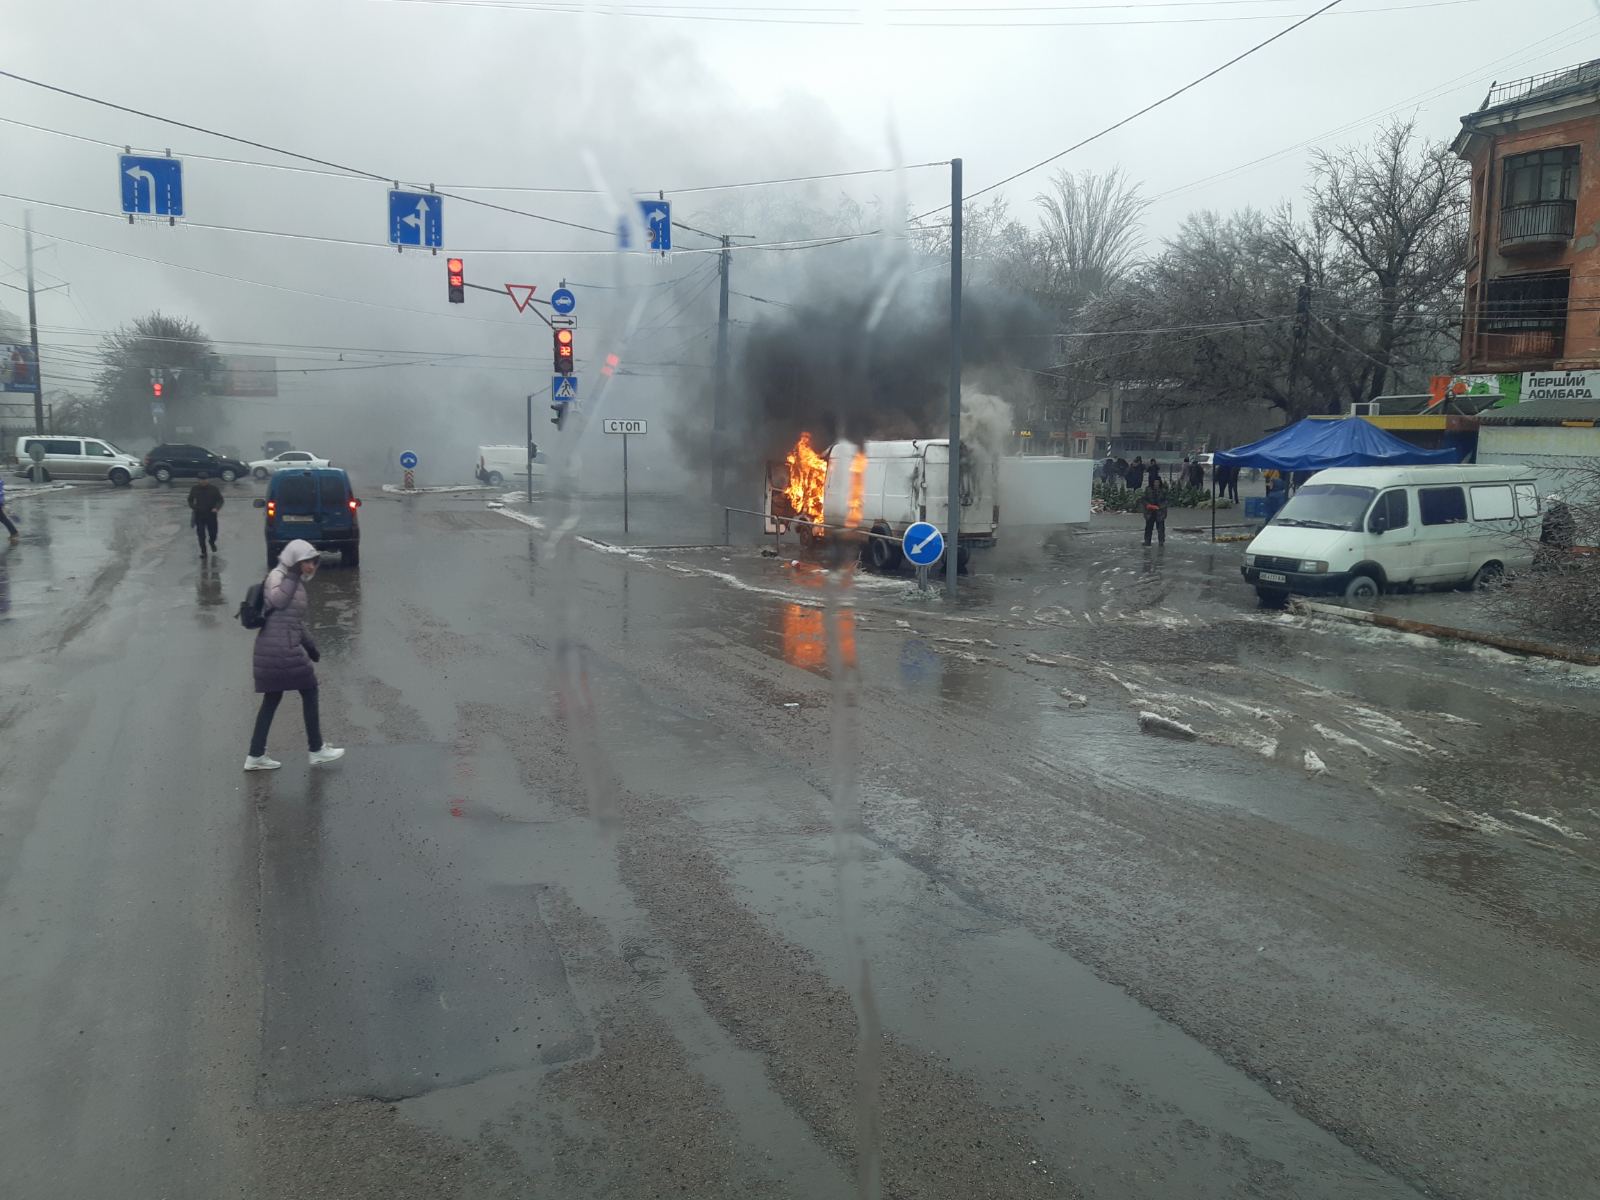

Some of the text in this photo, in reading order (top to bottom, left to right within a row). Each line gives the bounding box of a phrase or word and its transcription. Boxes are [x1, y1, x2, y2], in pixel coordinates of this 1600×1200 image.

[560, 346, 571, 356] 32
[1528, 375, 1586, 387] ПЕРШИЙ
[1528, 388, 1592, 399] ЛОМБАРД
[610, 421, 641, 432] СТОП
